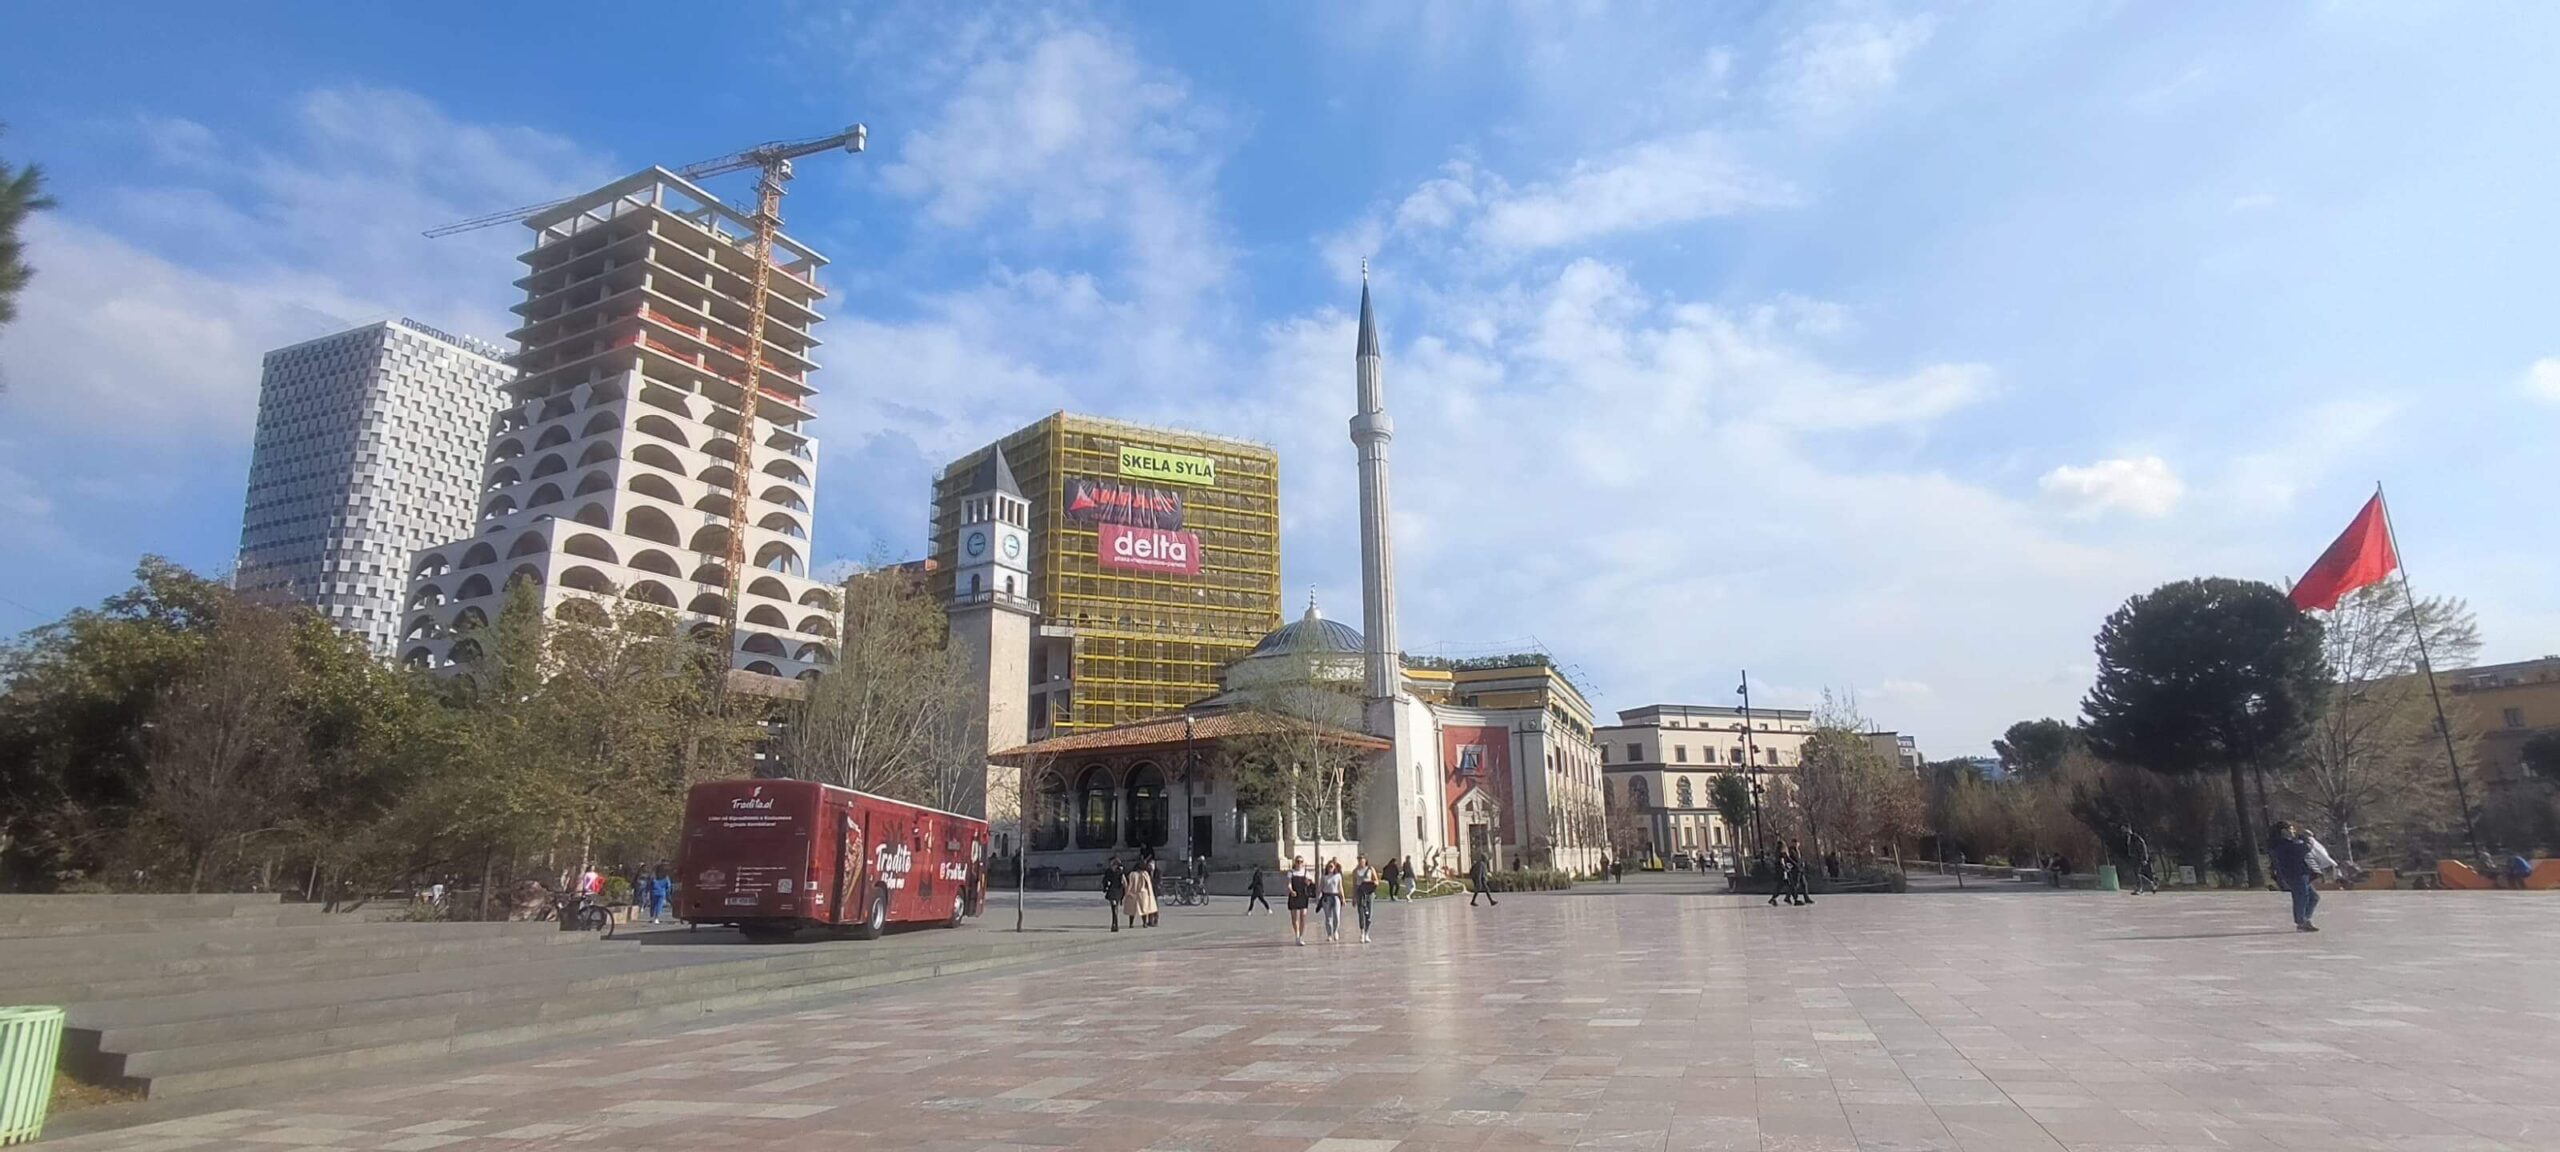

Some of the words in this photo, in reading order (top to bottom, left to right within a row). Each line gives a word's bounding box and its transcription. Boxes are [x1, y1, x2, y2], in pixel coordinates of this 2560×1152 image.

[1122, 453, 1171, 473] SKELA
[1175, 461, 1213, 478] SYLA
[1114, 530, 1187, 562] delta
